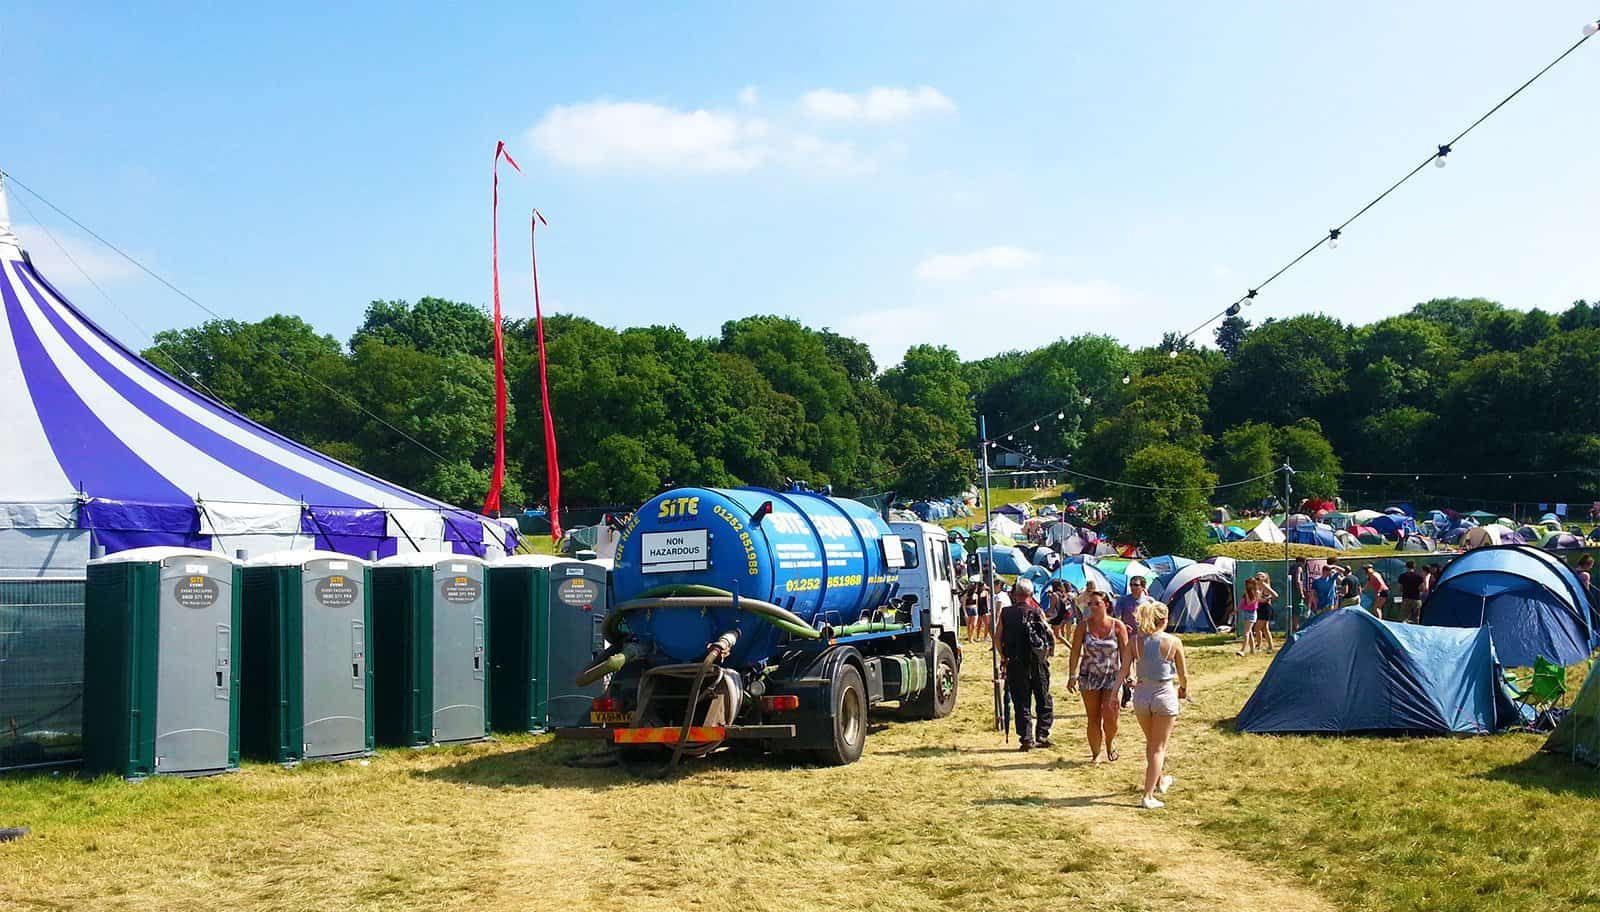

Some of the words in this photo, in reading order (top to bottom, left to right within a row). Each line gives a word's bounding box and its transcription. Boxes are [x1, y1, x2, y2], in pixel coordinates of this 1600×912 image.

[615, 544, 625, 568] FOR
[622, 517, 640, 542] HIRE
[666, 537, 684, 546] NON
[713, 505, 744, 533] 01252
[739, 531, 759, 576] 851988
[650, 546, 700, 557] HAZARDOUS
[786, 578, 821, 592] 01252
[827, 575, 862, 588] 851988
